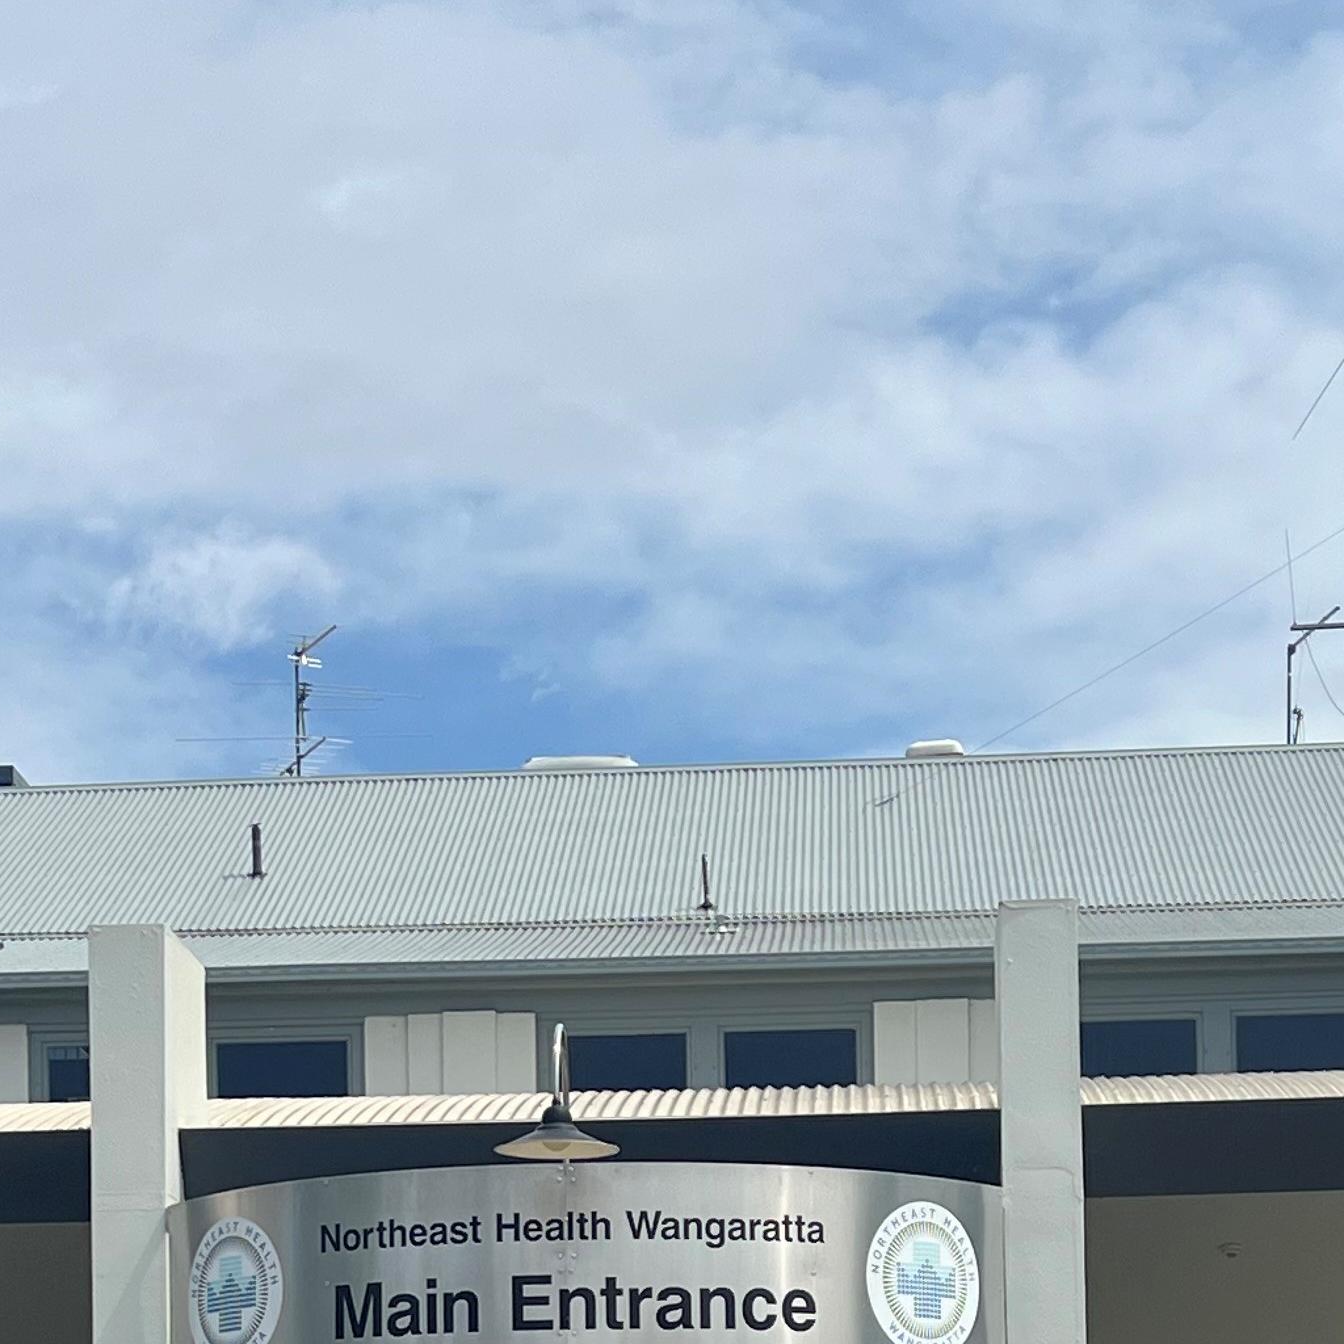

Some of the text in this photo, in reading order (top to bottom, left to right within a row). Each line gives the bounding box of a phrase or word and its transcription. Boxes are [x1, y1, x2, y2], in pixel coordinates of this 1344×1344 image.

[191, 1221, 279, 1299] NORTHEAST HEALTH
[320, 1210, 825, 1253] Northeast Health Wangaratta
[871, 1207, 976, 1282] NORTHEAST HEALTH
[334, 1274, 817, 1340] Main Entrance
